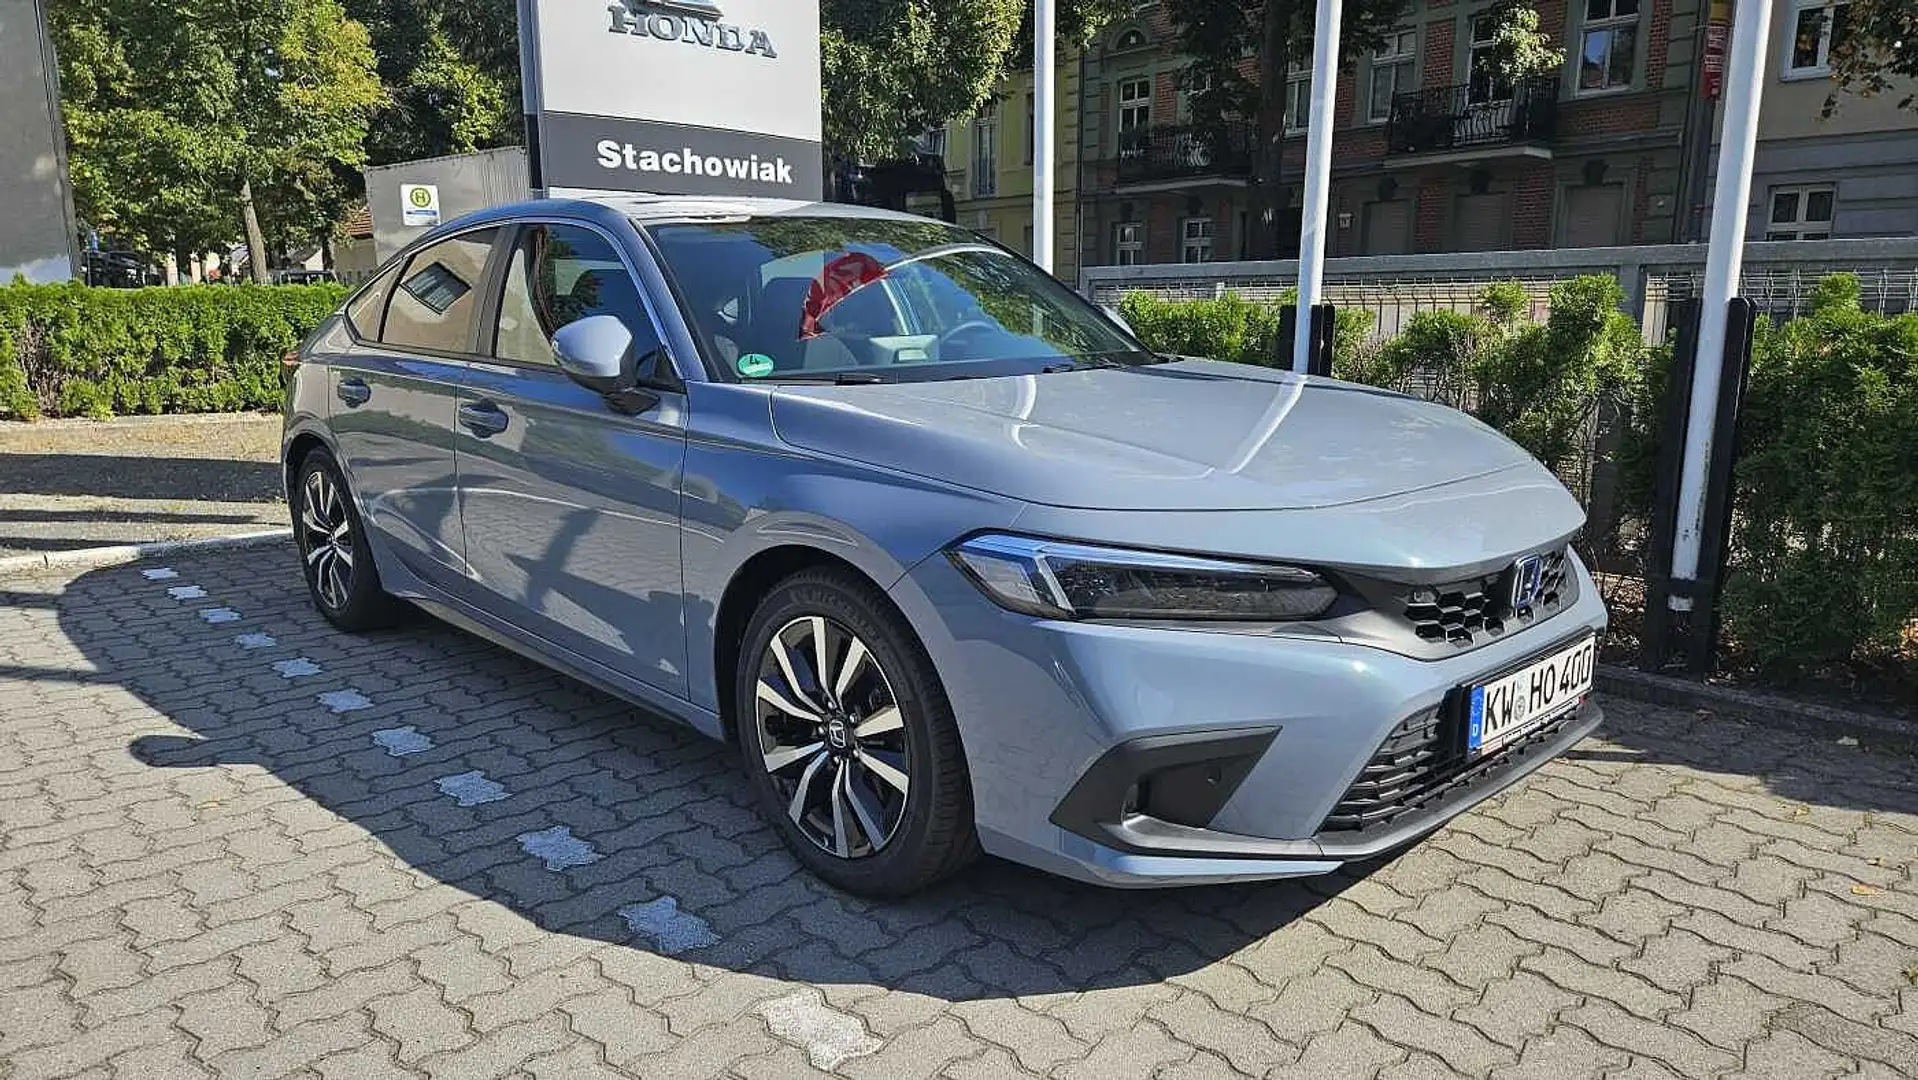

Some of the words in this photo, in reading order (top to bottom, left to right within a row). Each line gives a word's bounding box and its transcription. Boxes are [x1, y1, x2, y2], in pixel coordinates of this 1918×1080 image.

[607, 5, 778, 59] HONDA
[596, 139, 794, 184] Stachowiak
[415, 191, 426, 203] H
[1484, 680, 1517, 735] KW
[1529, 664, 1556, 714] HO
[1559, 644, 1592, 694] 400
[1472, 723, 1479, 737] D
